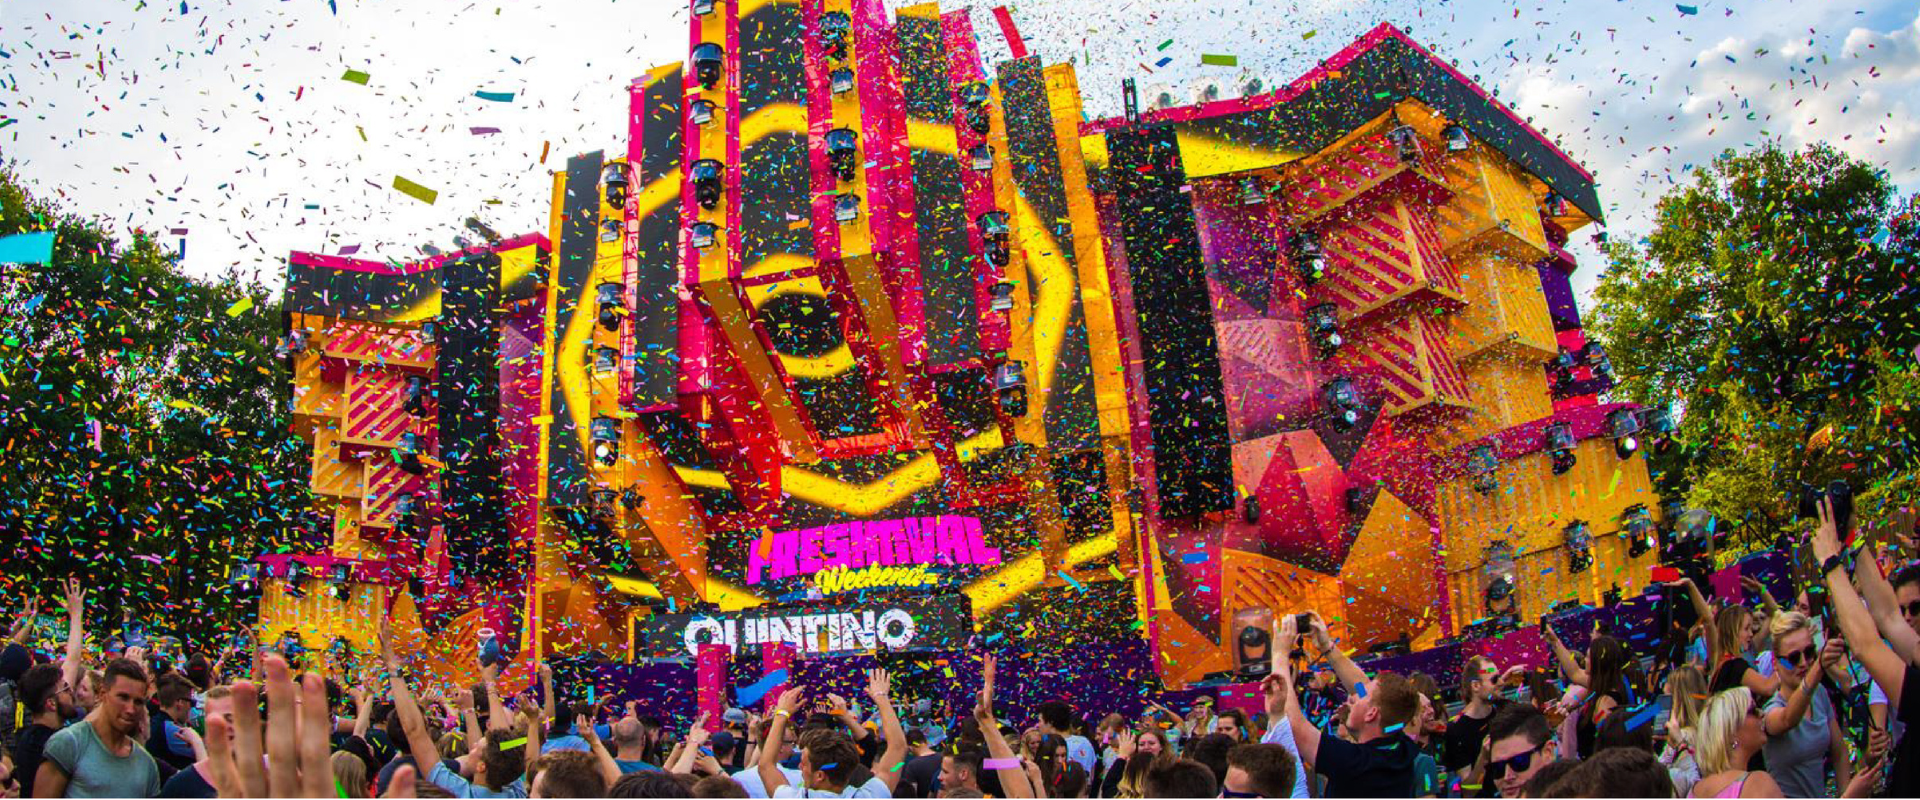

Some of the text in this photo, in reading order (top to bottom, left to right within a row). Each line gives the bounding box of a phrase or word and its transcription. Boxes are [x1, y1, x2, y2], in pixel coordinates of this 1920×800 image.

[747, 514, 1001, 585] FRESHTIVAL
[814, 561, 937, 595] Weekend
[684, 608, 915, 655] QUINTINO
